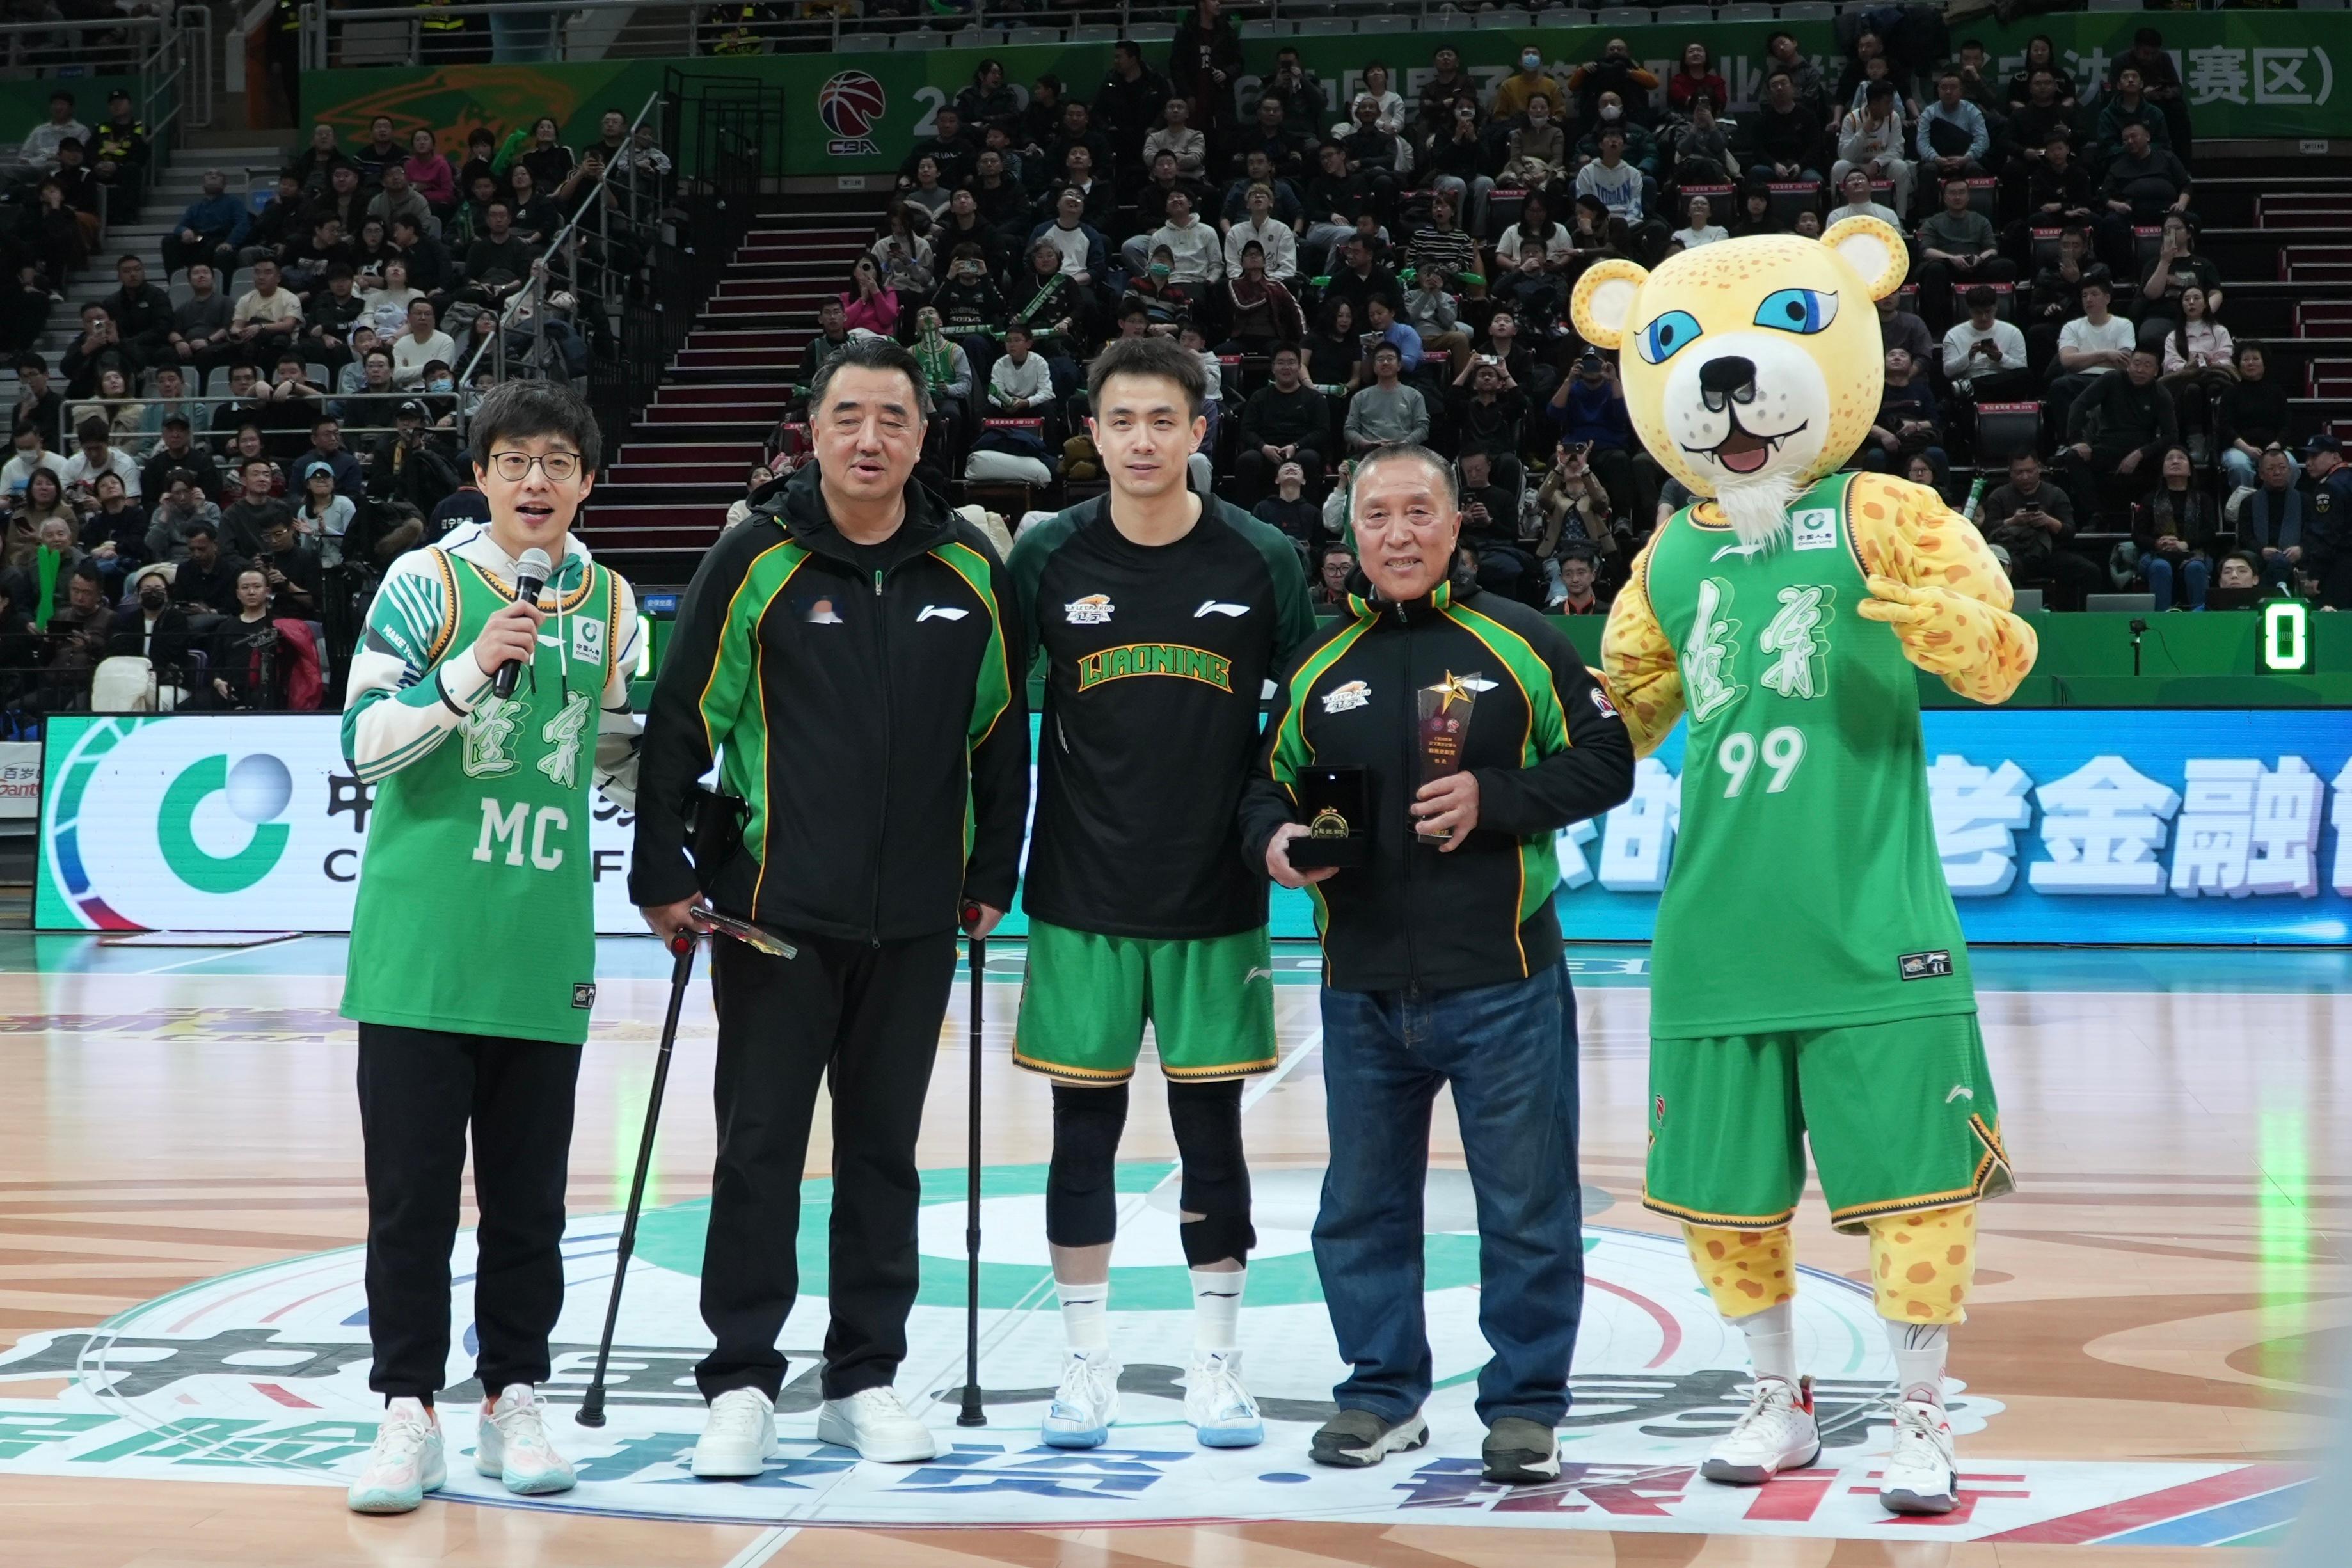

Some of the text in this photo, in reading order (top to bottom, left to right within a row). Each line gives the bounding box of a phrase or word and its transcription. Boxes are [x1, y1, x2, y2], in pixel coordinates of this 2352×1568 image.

[827, 139, 882, 155] CBA
[382, 624, 407, 649] MAKE
[2265, 603, 2305, 669] 0
[1078, 643, 1233, 693] LIAONING
[1719, 726, 1808, 799] 99
[472, 796, 569, 871] MC
